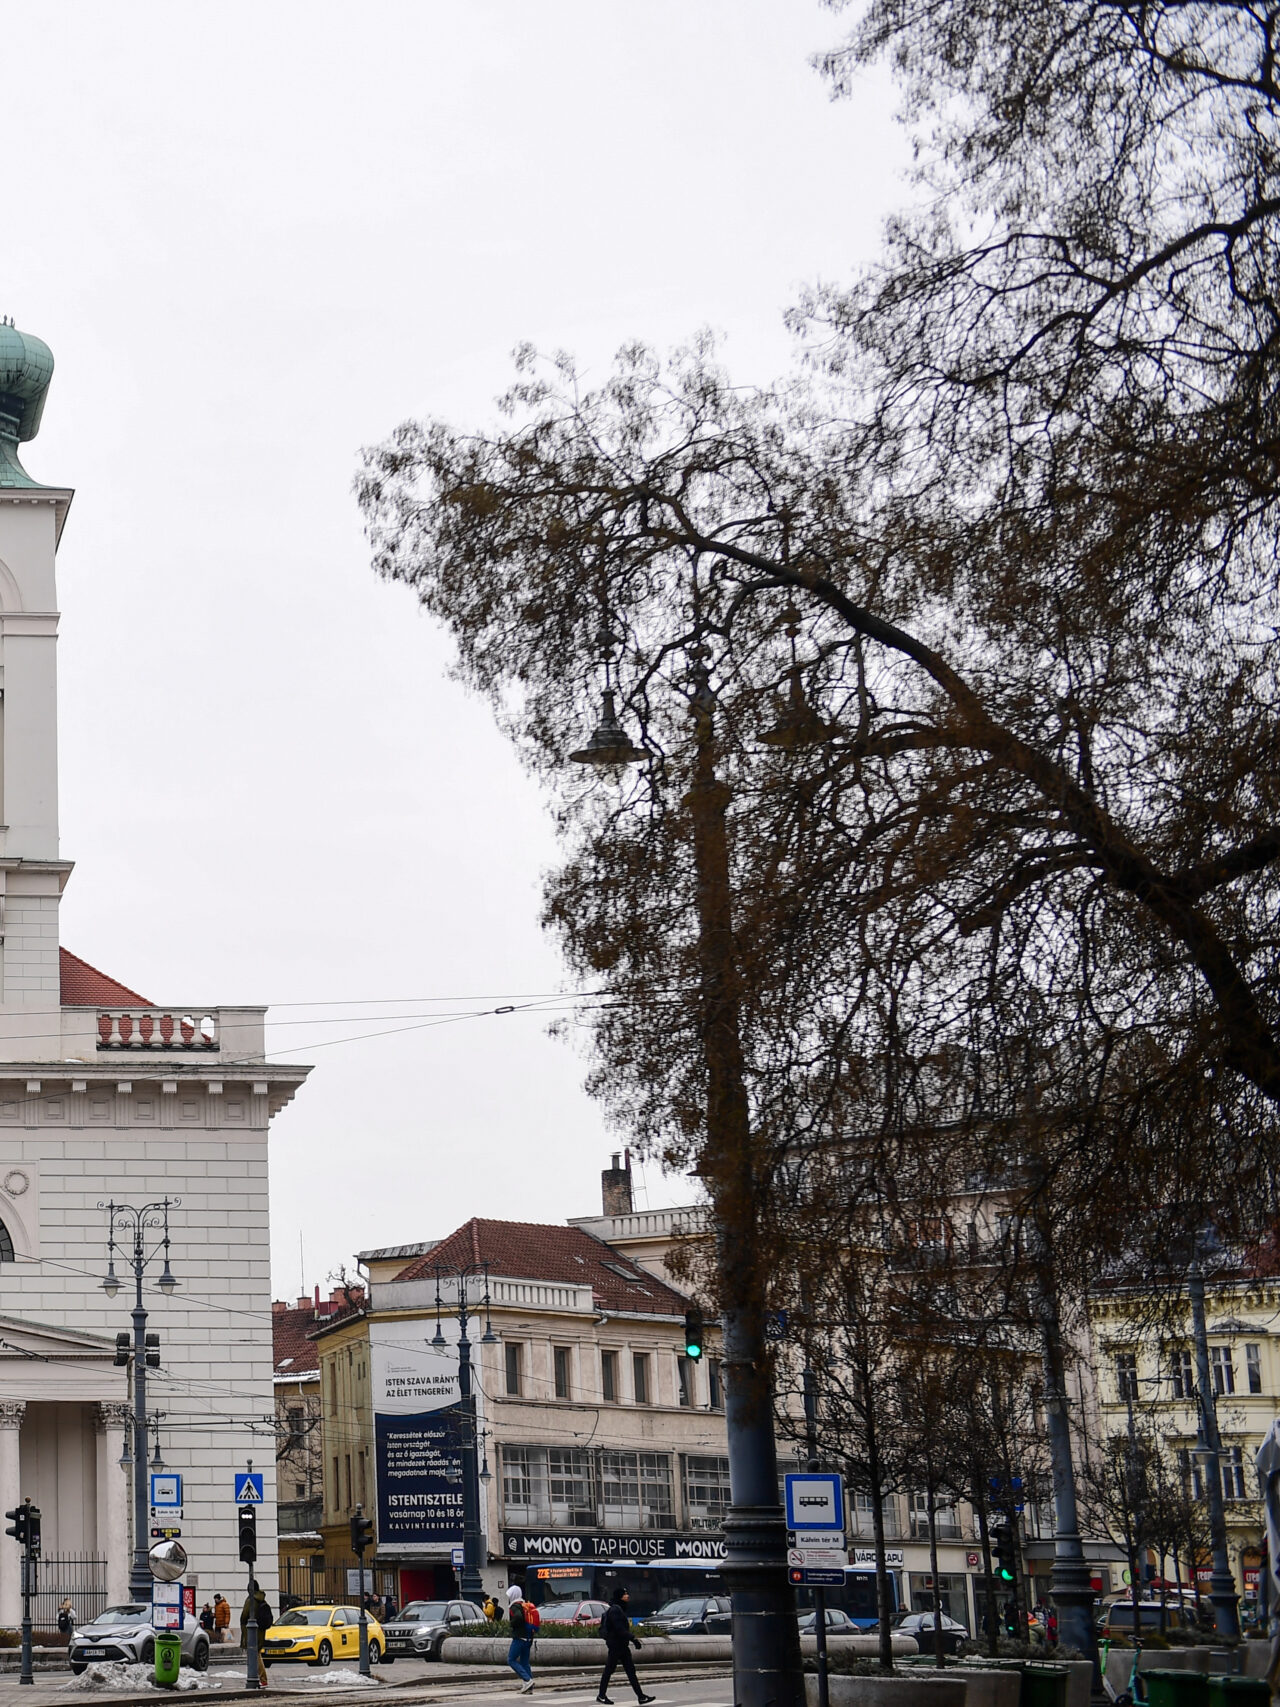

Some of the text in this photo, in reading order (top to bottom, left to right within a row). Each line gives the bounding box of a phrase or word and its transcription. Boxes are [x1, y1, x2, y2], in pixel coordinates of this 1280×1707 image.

[385, 1374, 460, 1387] ISTEN SZAVA IRÁNYT
[386, 1385, 454, 1398] AZ ÉLET TENGERÉN!
[387, 1460, 395, 1468] és
[388, 1493, 463, 1506] ISTENTISZTELE
[389, 1508, 464, 1520] vasárnap 10 és 18 ór
[389, 1522, 464, 1530] KALVINTERIREF.H
[523, 1536, 582, 1555] MONYO
[592, 1537, 617, 1556] TAP
[619, 1538, 665, 1556] HOUSE
